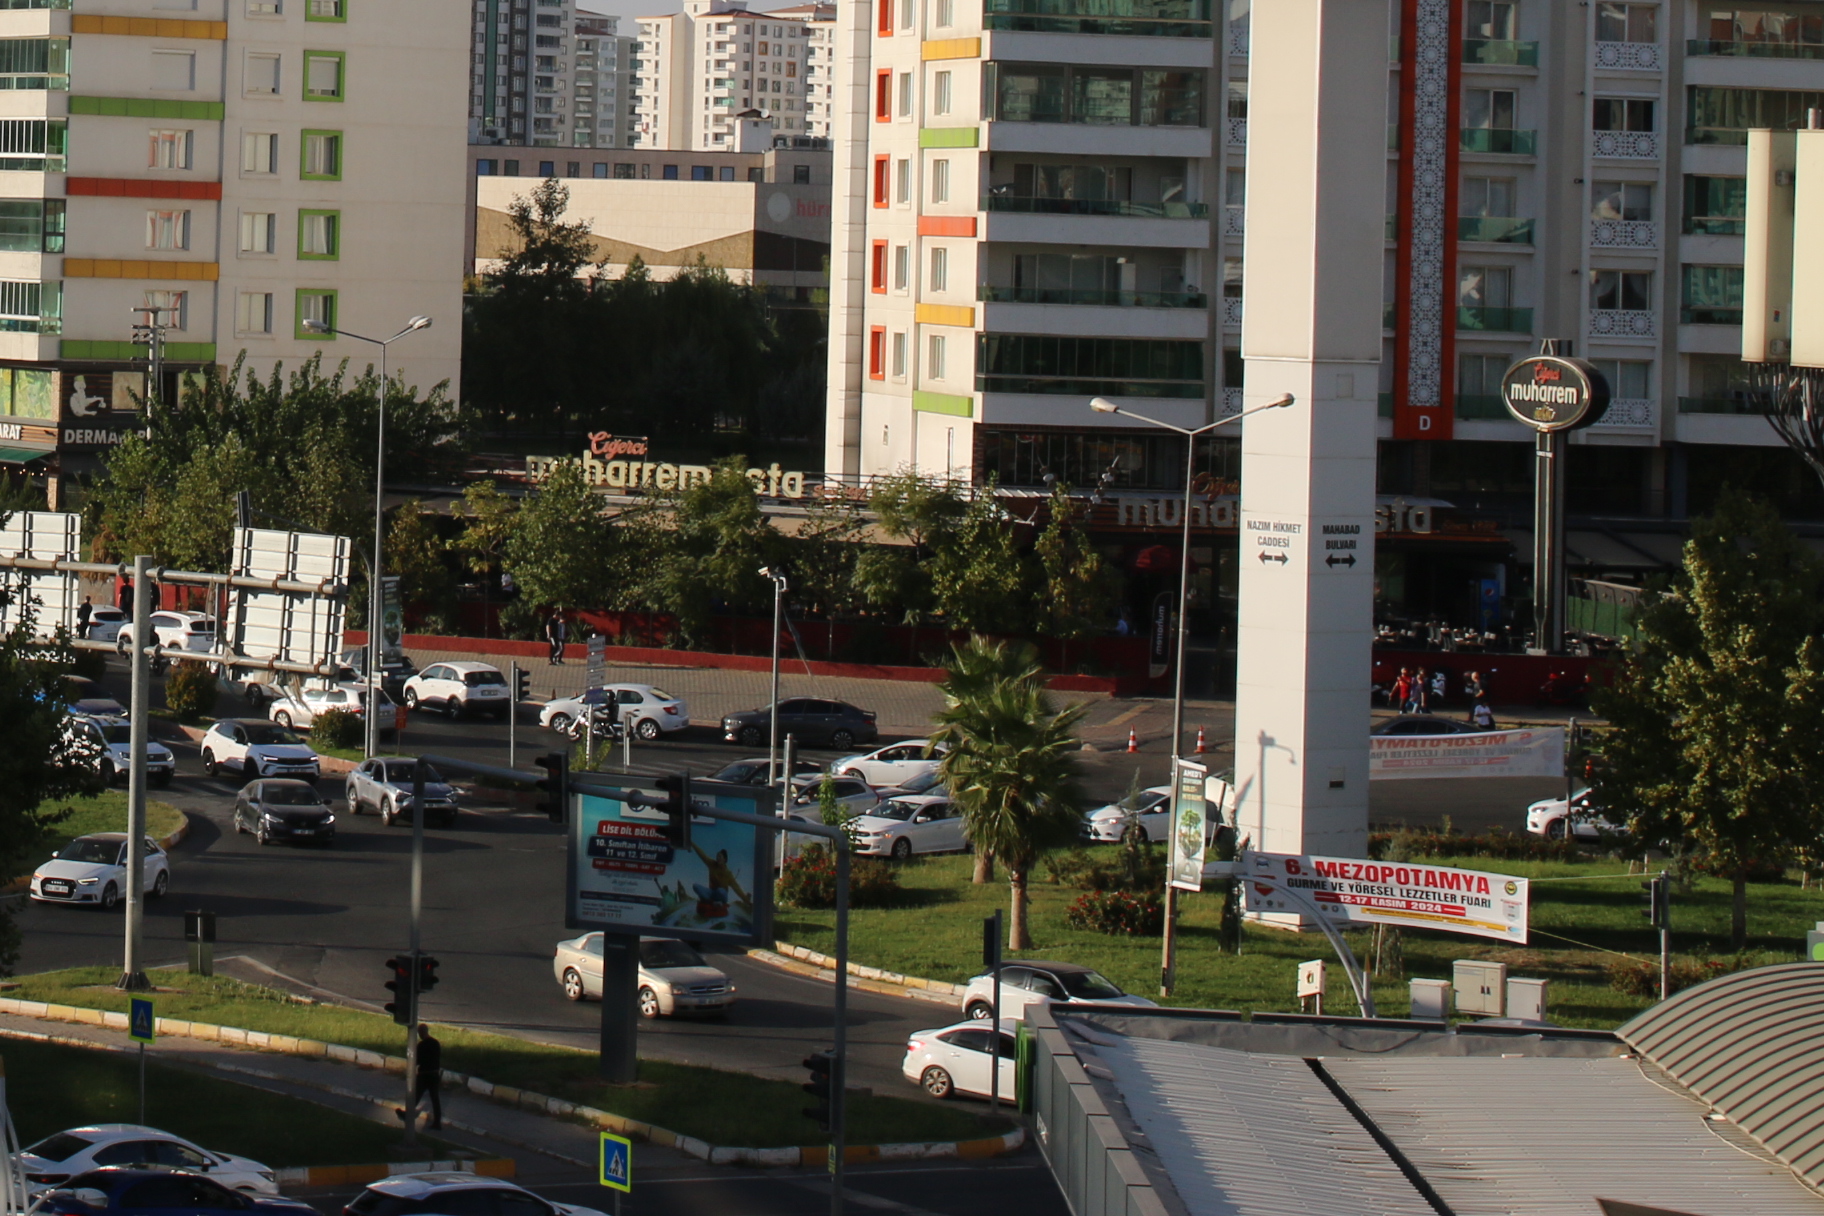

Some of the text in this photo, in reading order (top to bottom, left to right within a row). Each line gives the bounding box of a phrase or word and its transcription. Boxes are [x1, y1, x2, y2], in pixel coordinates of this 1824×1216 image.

[1511, 380, 1578, 404] muharrem
[1419, 415, 1431, 430] D
[64, 429, 126, 444] DERMA
[732, 462, 804, 498] sta
[1375, 496, 1432, 534] sta
[1247, 520, 1302, 534] NAZIM HİKMET
[1322, 524, 1360, 535] MAHABAD
[1257, 535, 1290, 548] CADDESİ
[1326, 539, 1357, 550] BULVARI
[602, 823, 666, 838] LİSE DİL BÖLÜ
[595, 838, 667, 852] 10. Sınıftan İtibaren
[628, 850, 638, 859] 12.
[640, 851, 657, 860] Sınıf
[1285, 858, 1490, 895] 6. MEZOPOTAMYA
[1287, 877, 1327, 890] GURME
[1330, 881, 1345, 892] VE
[1348, 881, 1396, 897] YÖRESEL
[1400, 888, 1457, 903] LEZZETLER
[1461, 895, 1491, 909] FUARI
[1338, 894, 1442, 913] 12-17 KASIM 2024
